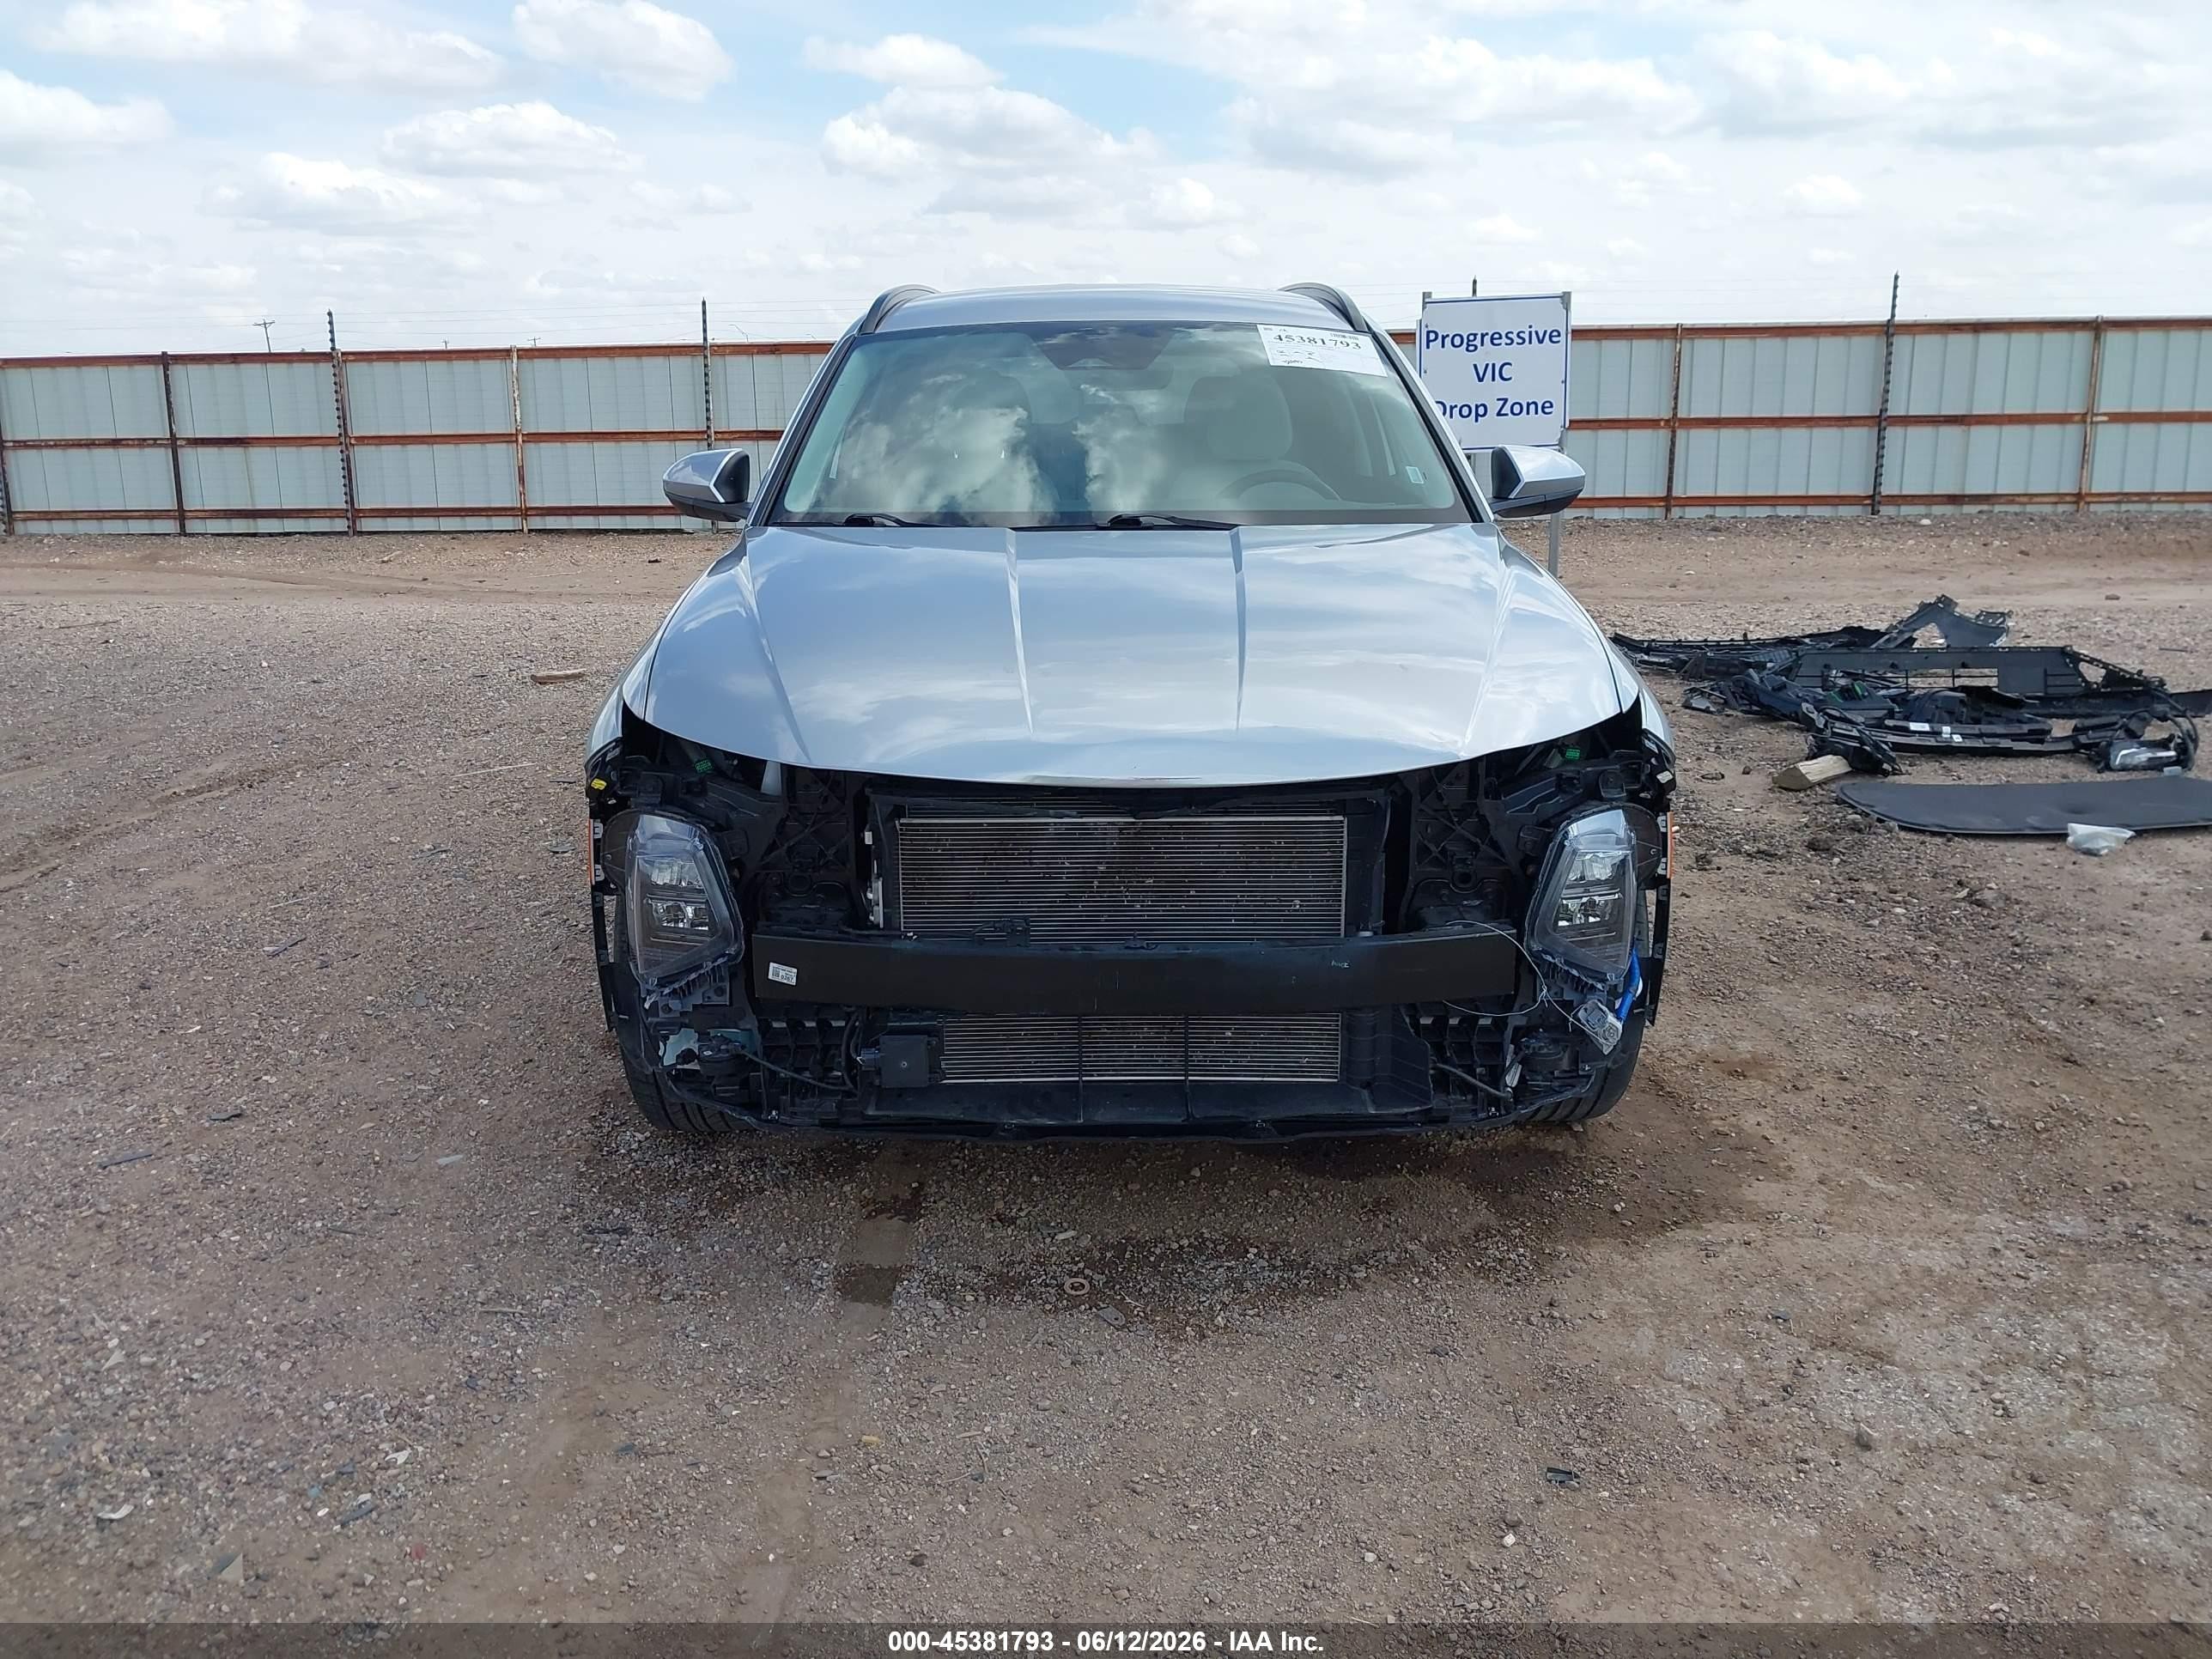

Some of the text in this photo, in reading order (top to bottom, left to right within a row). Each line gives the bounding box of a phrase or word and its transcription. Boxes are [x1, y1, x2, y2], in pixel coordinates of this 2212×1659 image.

[1273, 334, 1362, 350] 45381793
[1425, 325, 1561, 352] Progressive
[1473, 362, 1513, 383] VIC
[1496, 397, 1554, 417] Zone
